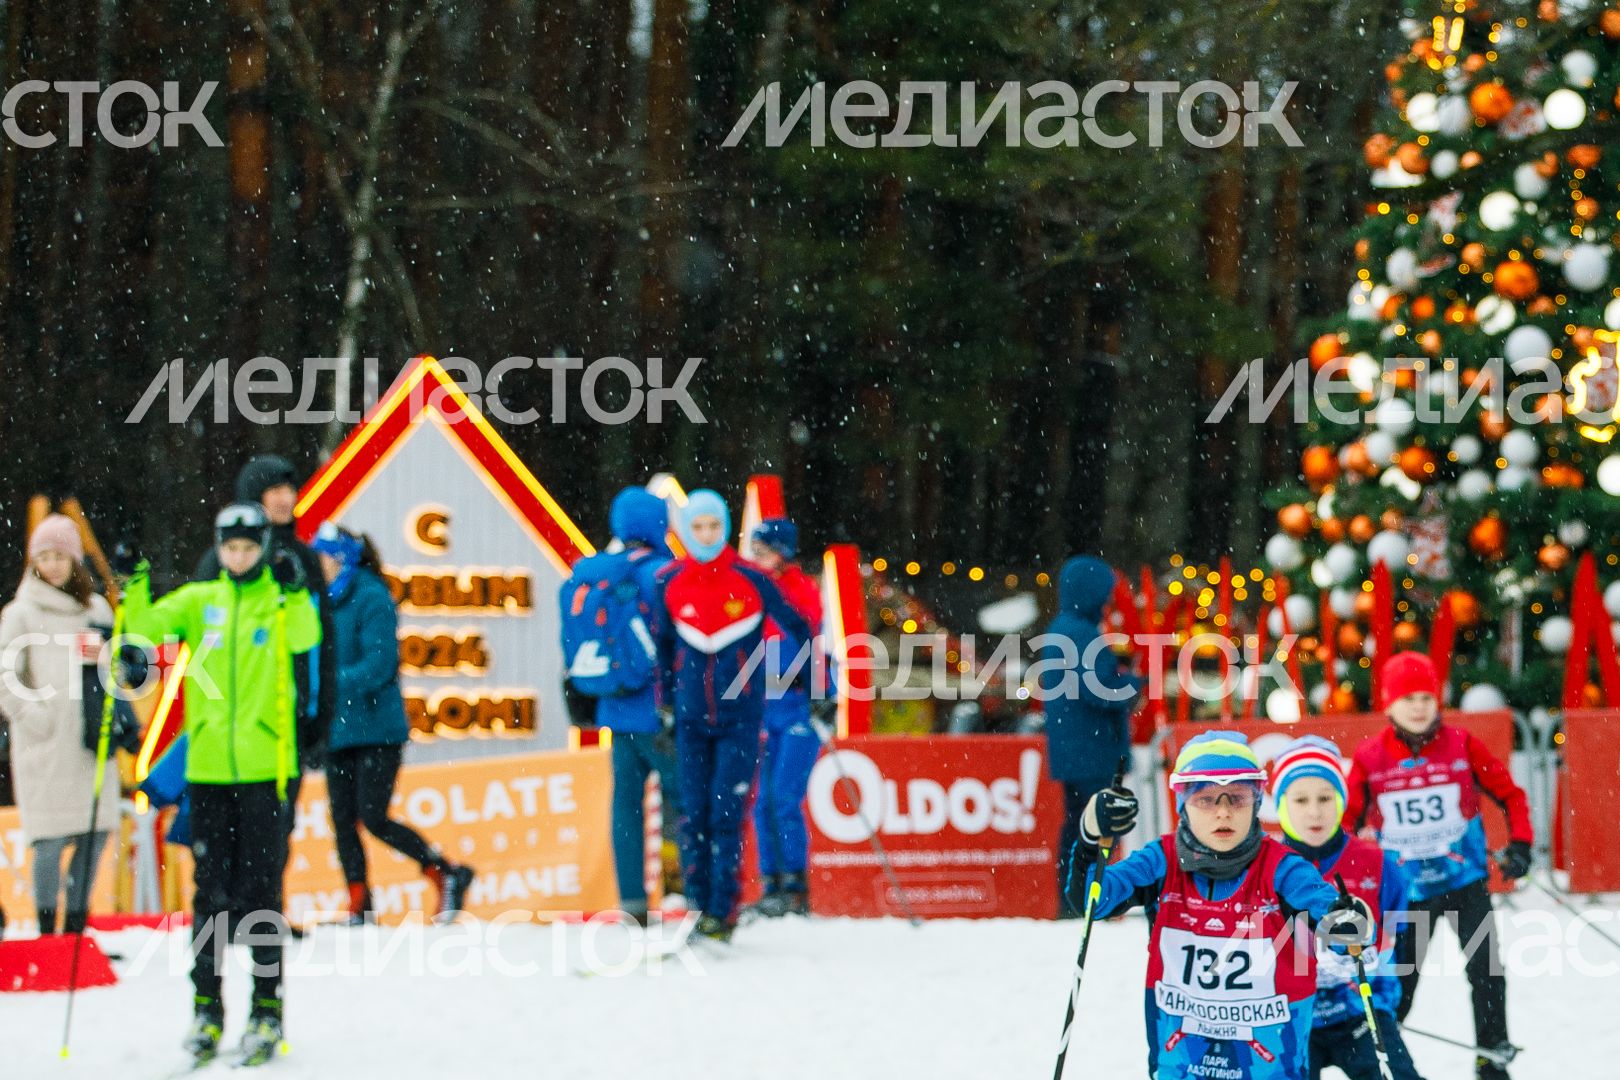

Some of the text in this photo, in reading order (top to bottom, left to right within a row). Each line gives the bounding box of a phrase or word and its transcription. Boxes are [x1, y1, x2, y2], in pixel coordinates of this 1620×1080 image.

[400, 634, 487, 668] 026
[1393, 794, 1446, 825] 153
[1181, 944, 1254, 991] 132
[1202, 1055, 1229, 1068] ПАРК
